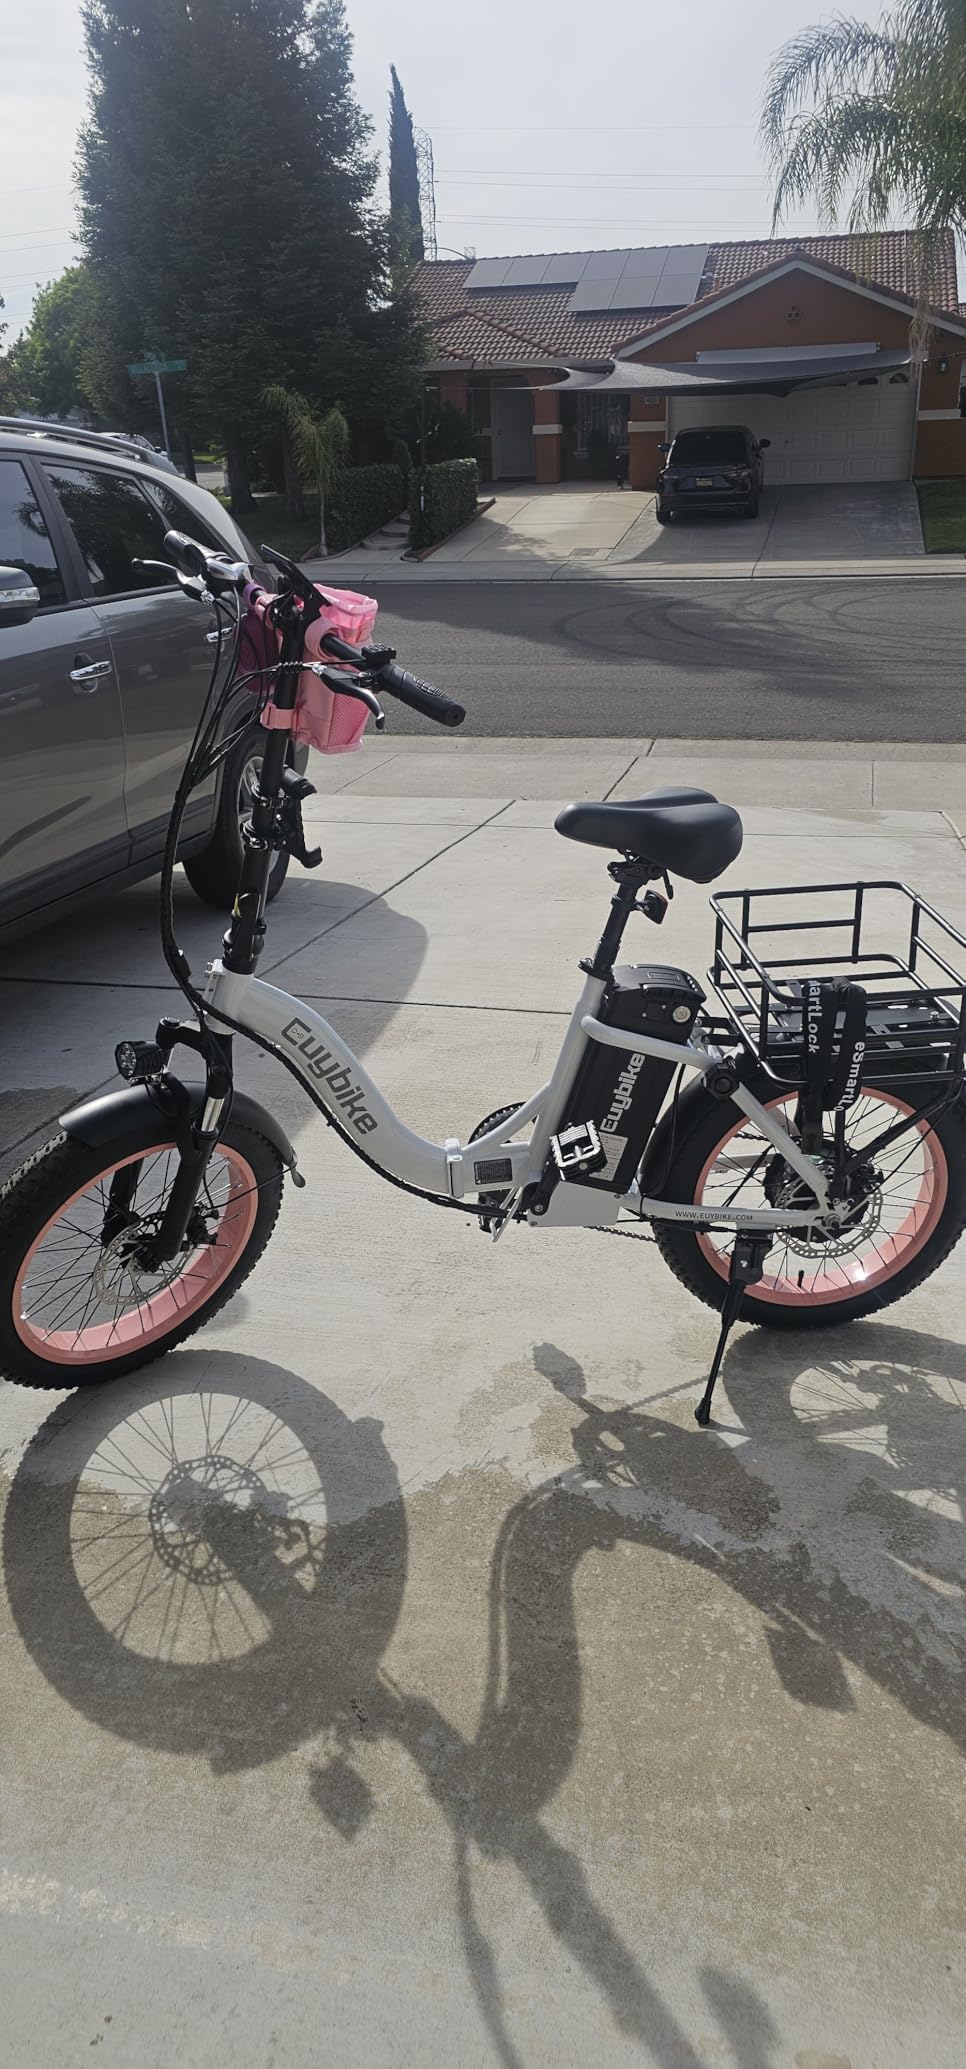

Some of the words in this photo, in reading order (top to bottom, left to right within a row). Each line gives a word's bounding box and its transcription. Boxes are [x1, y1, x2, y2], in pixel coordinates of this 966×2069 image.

[281, 1017, 378, 1135] Euybike
[600, 1053, 646, 1133] Euybike
[675, 1210, 753, 1221] WWW.EUYBIKE.COM
